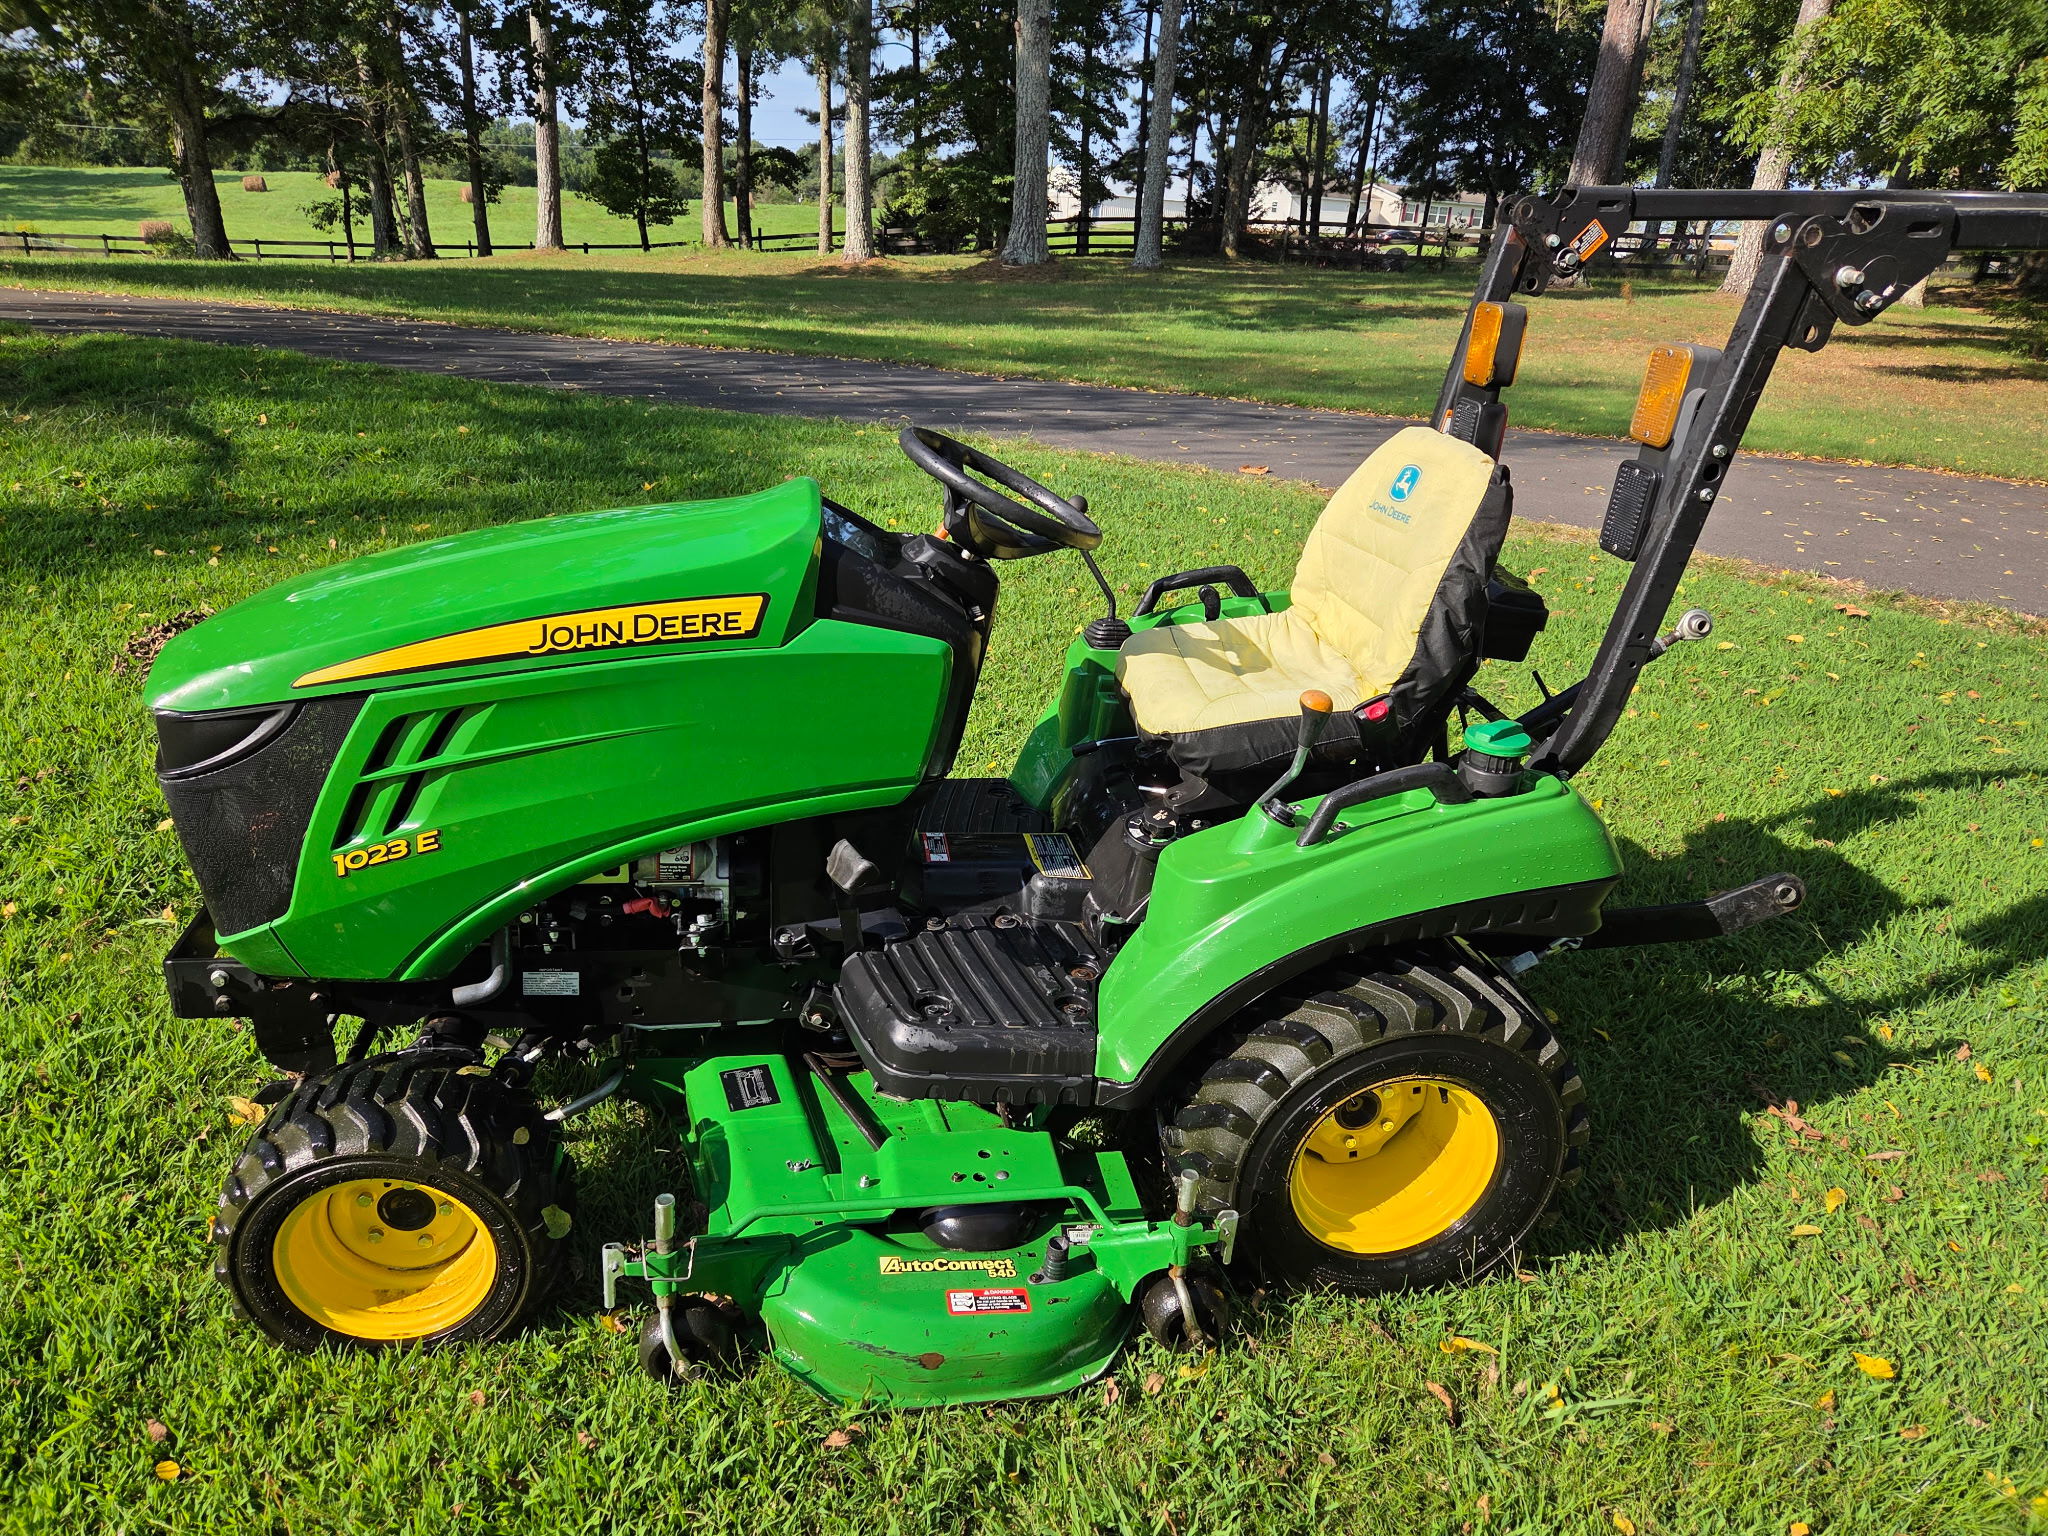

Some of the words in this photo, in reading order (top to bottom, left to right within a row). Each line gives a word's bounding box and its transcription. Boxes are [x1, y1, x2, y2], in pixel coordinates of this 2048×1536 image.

[1369, 501, 1388, 514] JOHN
[1387, 507, 1412, 524] DEERE
[529, 620, 624, 651] JOHN
[633, 611, 742, 639] DEERE
[332, 839, 412, 877] 1023
[416, 829, 443, 854] E
[882, 1257, 1015, 1273] AutoConnect
[986, 1268, 1017, 1278] 54D
